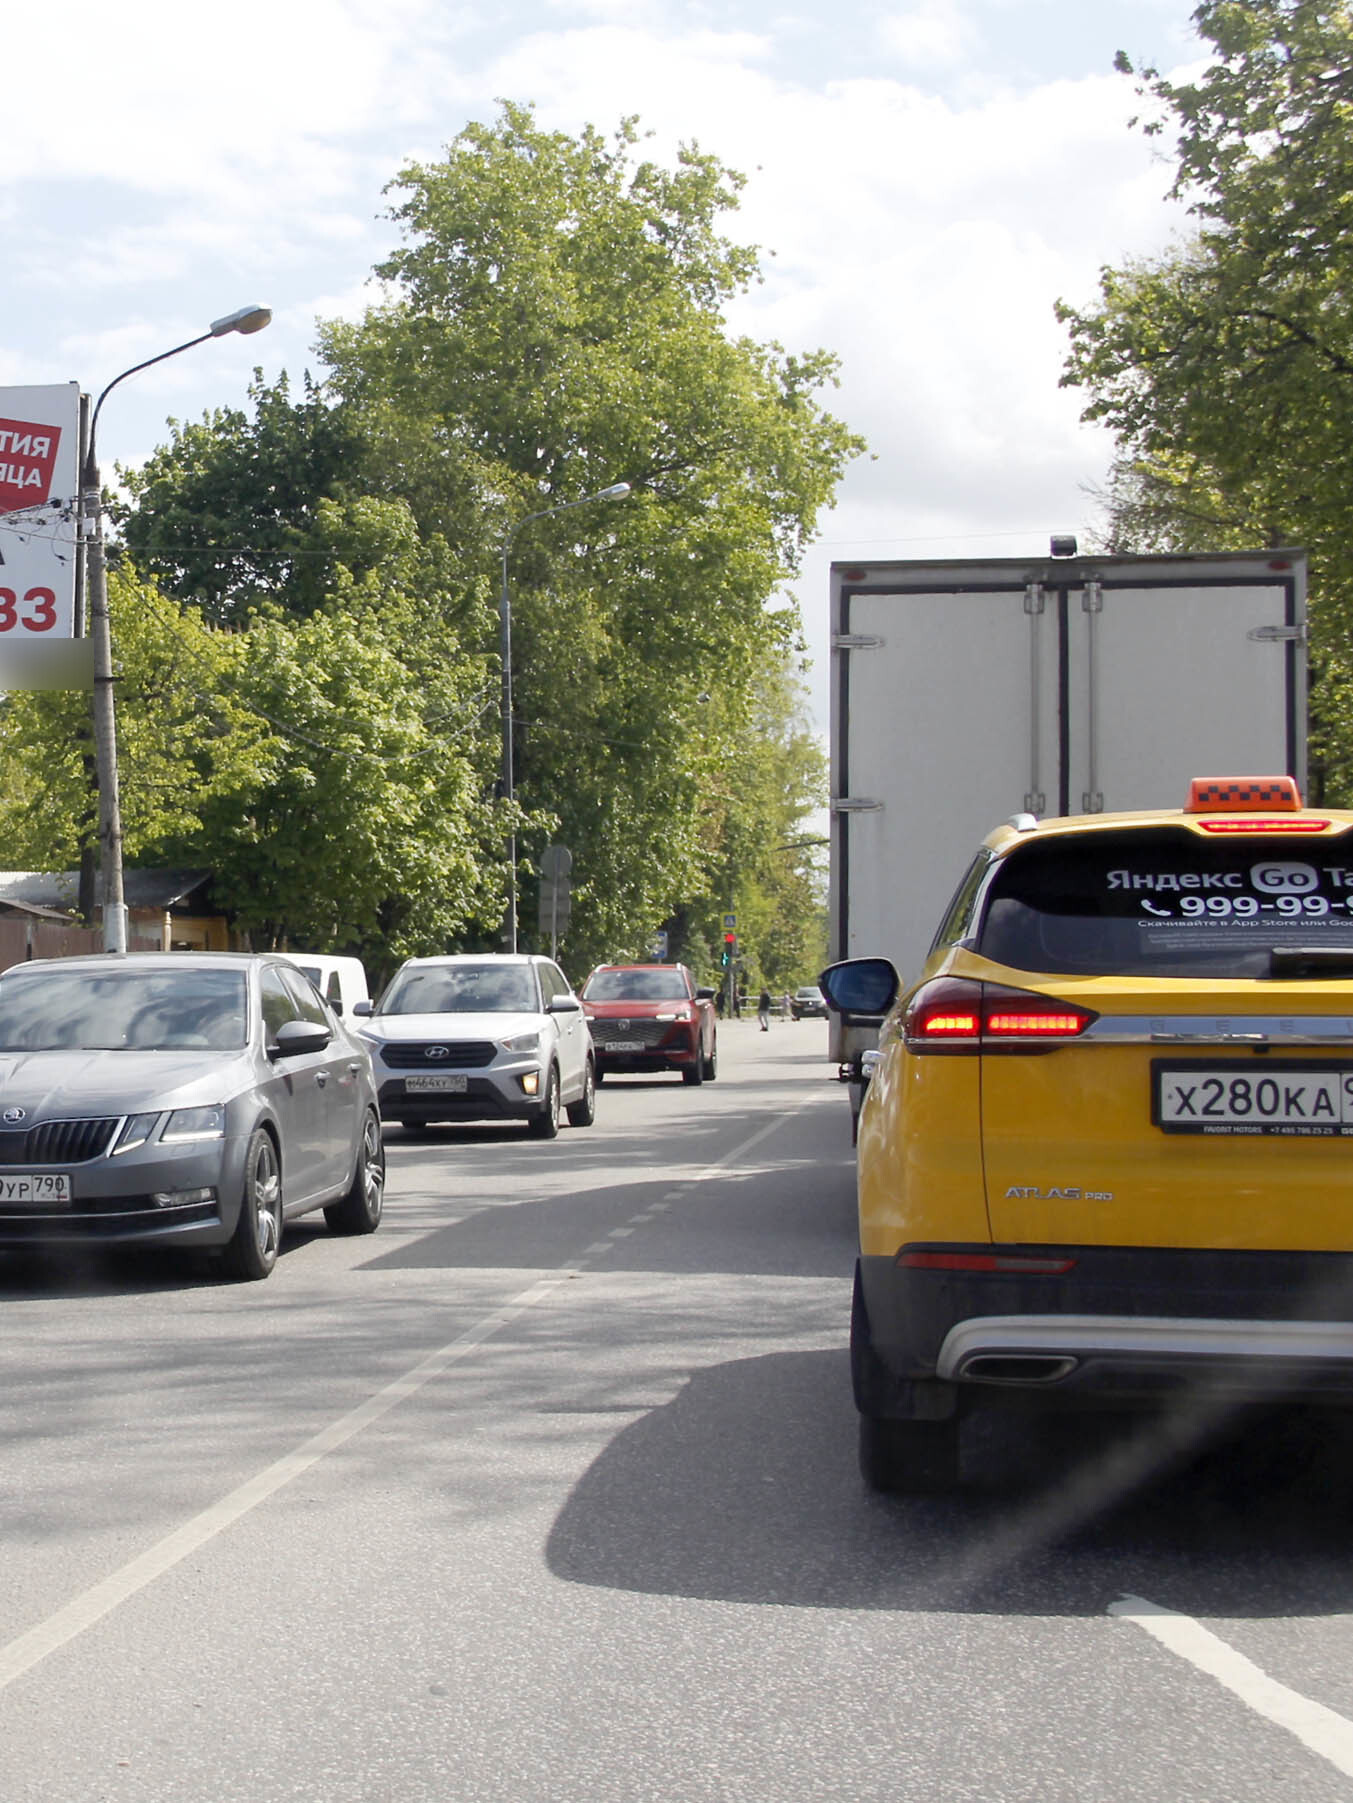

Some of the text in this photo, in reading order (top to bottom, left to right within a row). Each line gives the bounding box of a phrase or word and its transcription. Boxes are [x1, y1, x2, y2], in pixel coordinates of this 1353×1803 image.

[1106, 870, 1243, 892] Яндекс
[1259, 868, 1310, 887] Go
[1137, 919, 1217, 928] Скачивайте
[1231, 919, 1260, 928] App
[1261, 919, 1297, 927] Store
[1175, 1078, 1335, 1117] Х280КА
[33, 1176, 64, 1192] 790
[1006, 1186, 1113, 1200] ATLAS PRO
